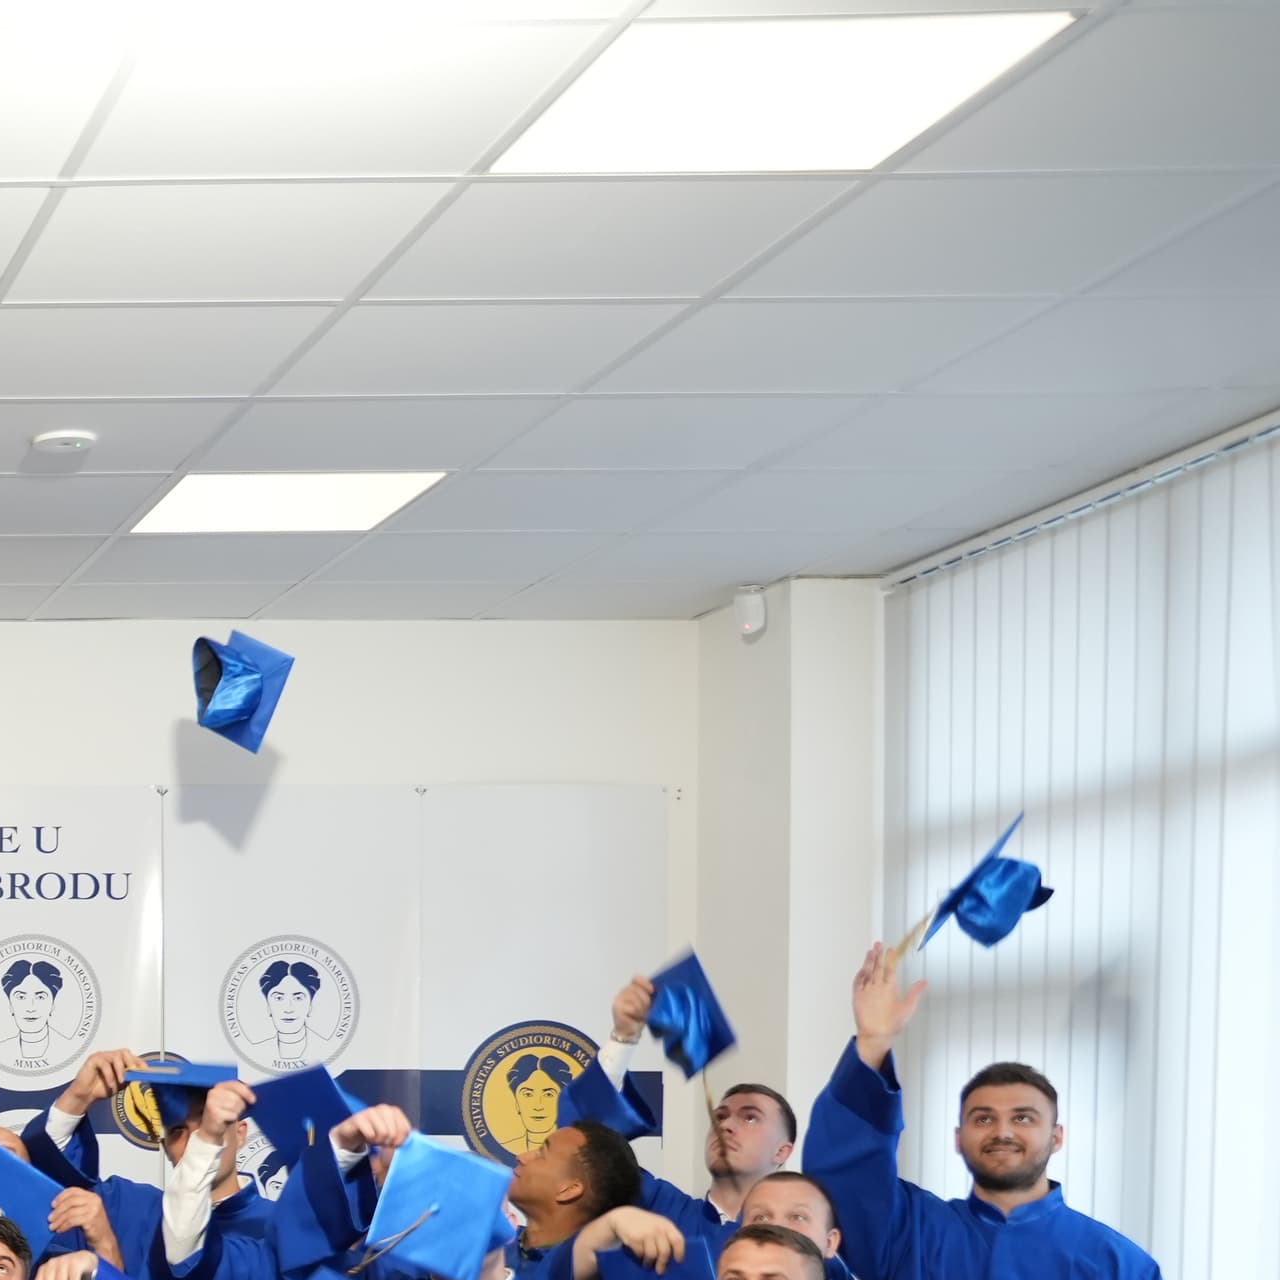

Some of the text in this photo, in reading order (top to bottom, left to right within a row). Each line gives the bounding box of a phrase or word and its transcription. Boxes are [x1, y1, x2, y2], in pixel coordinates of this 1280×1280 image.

[32, 826, 62, 854] U
[64, 955, 94, 1039] MARSONIENSIS
[225, 943, 352, 1039] UNIVERSITAS STUDIORUM MARSONIENSIS
[14, 1058, 50, 1069] MMXX
[272, 1059, 308, 1070] MMXX
[471, 1035, 572, 1138] UNIVERSITAS STUDIORUM
